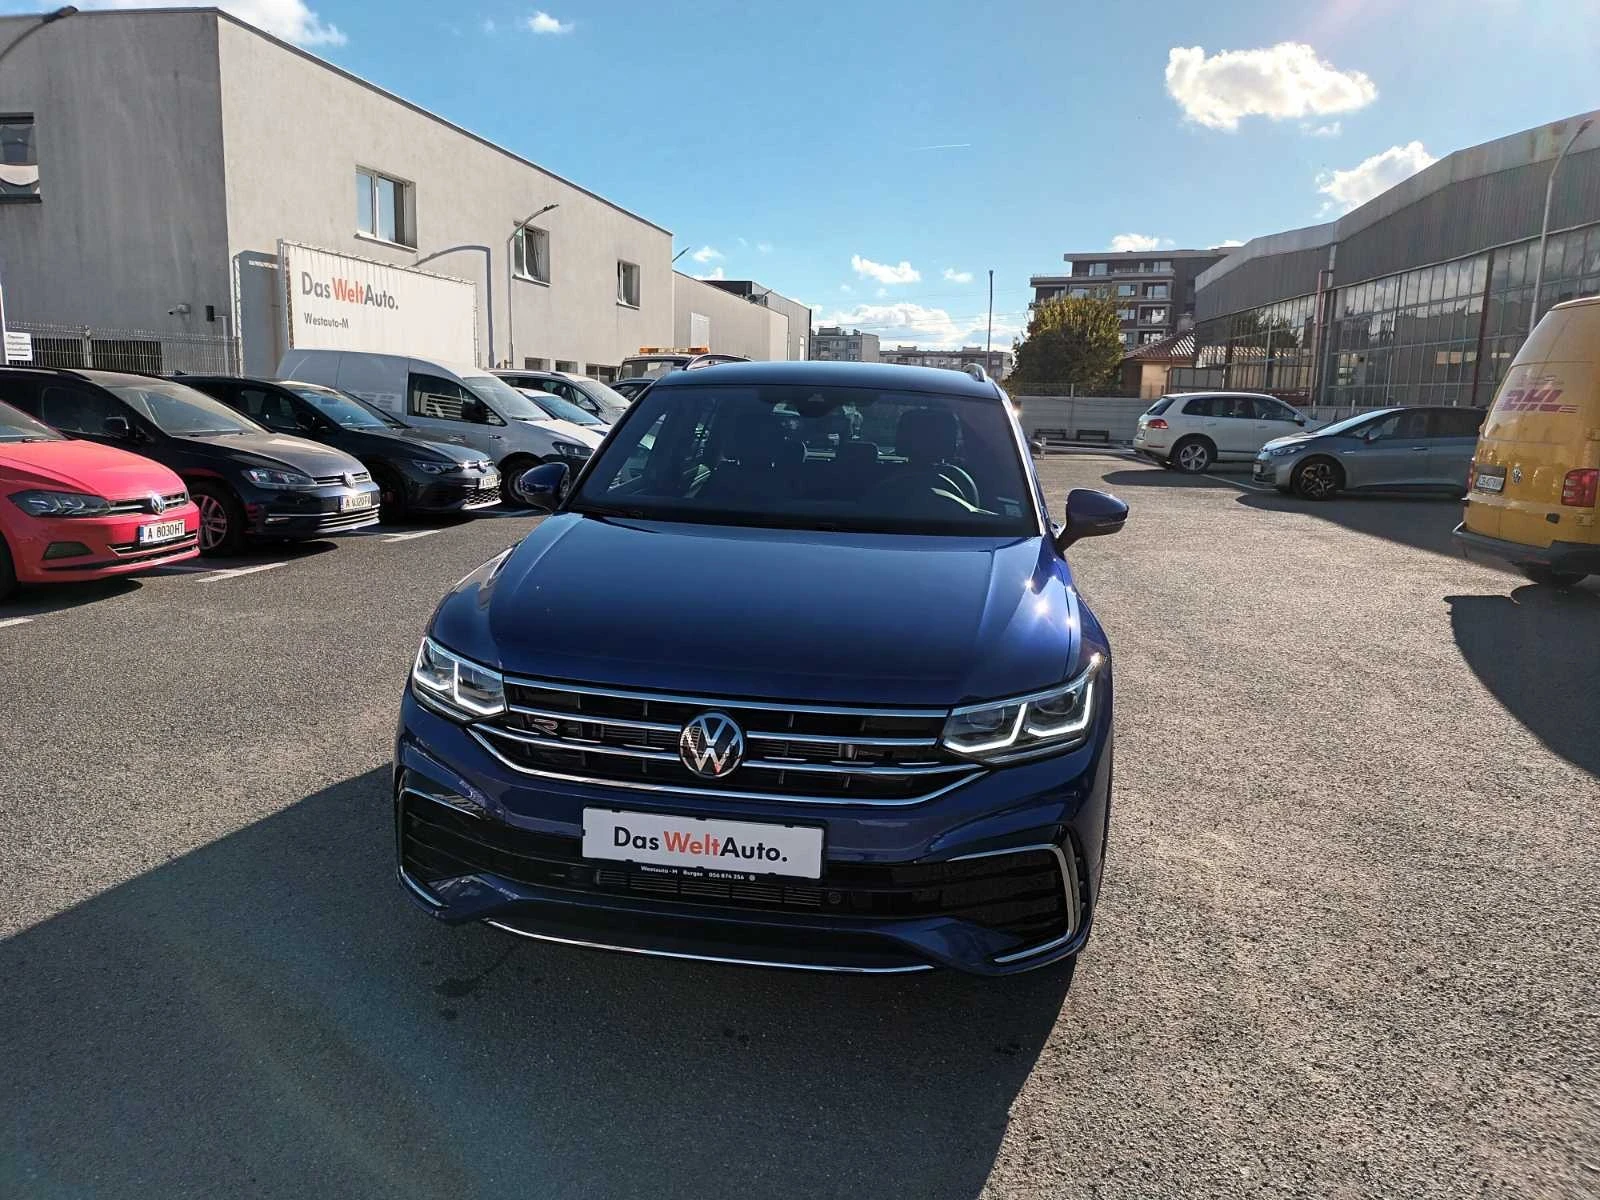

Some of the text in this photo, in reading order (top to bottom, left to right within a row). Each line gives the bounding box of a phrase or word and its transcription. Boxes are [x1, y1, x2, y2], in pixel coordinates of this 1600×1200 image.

[302, 271, 331, 299] Das
[304, 312, 349, 329] Westauto-M
[614, 826, 659, 850] Das
